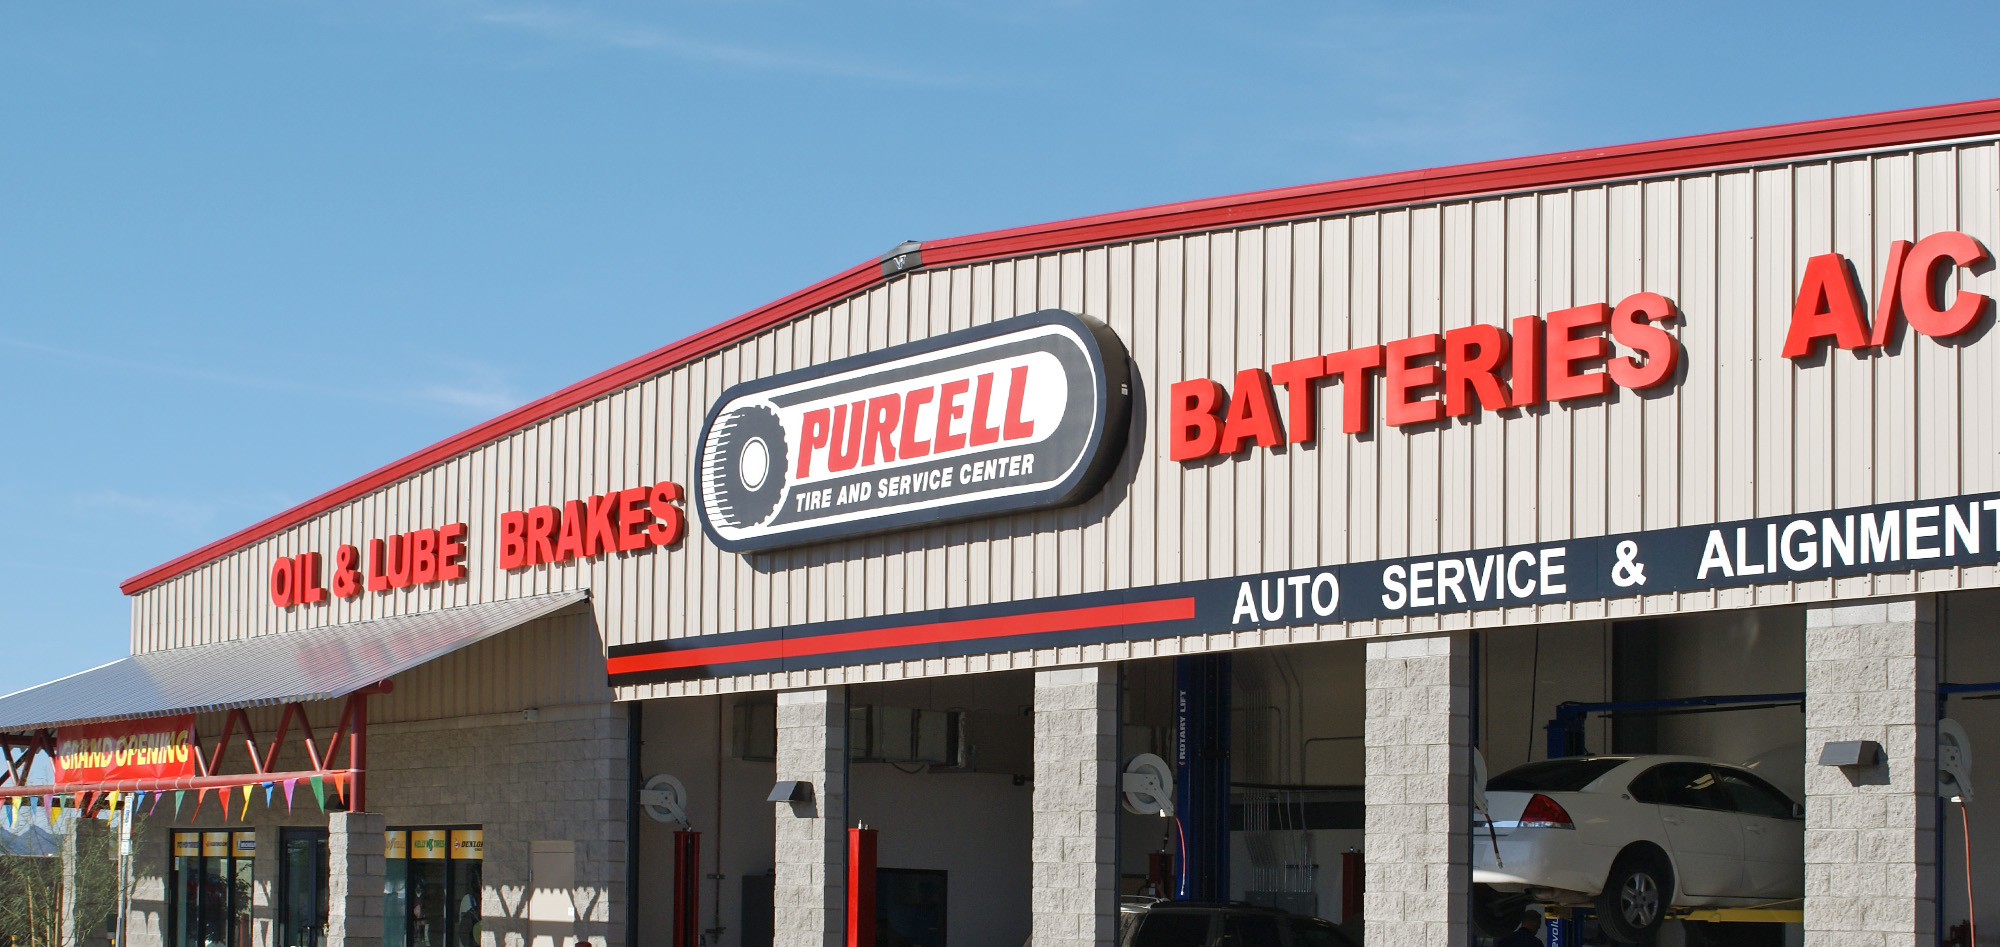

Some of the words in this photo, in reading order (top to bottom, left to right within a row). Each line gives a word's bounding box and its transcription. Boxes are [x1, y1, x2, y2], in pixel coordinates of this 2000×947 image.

[1781, 230, 1989, 359] A/C
[1170, 291, 1679, 462] BATTERIES
[796, 365, 1035, 479] PURCELL
[499, 480, 684, 570] BRAKES
[796, 488, 832, 512] TIRE
[836, 481, 872, 506] AND
[878, 467, 954, 499] SERVICE
[959, 453, 1035, 485] CENTER
[270, 551, 326, 608] OIL
[332, 543, 362, 599] &
[367, 522, 467, 592] LUBE
[1232, 572, 1340, 624] AUTO
[1381, 546, 1567, 611] SERVICE
[1611, 540, 1647, 587] &
[1179, 689, 1187, 713] LIFT
[1179, 715, 1187, 760] ROTARY
[60, 737, 113, 770] GRAND
[115, 729, 189, 767] OPENING
